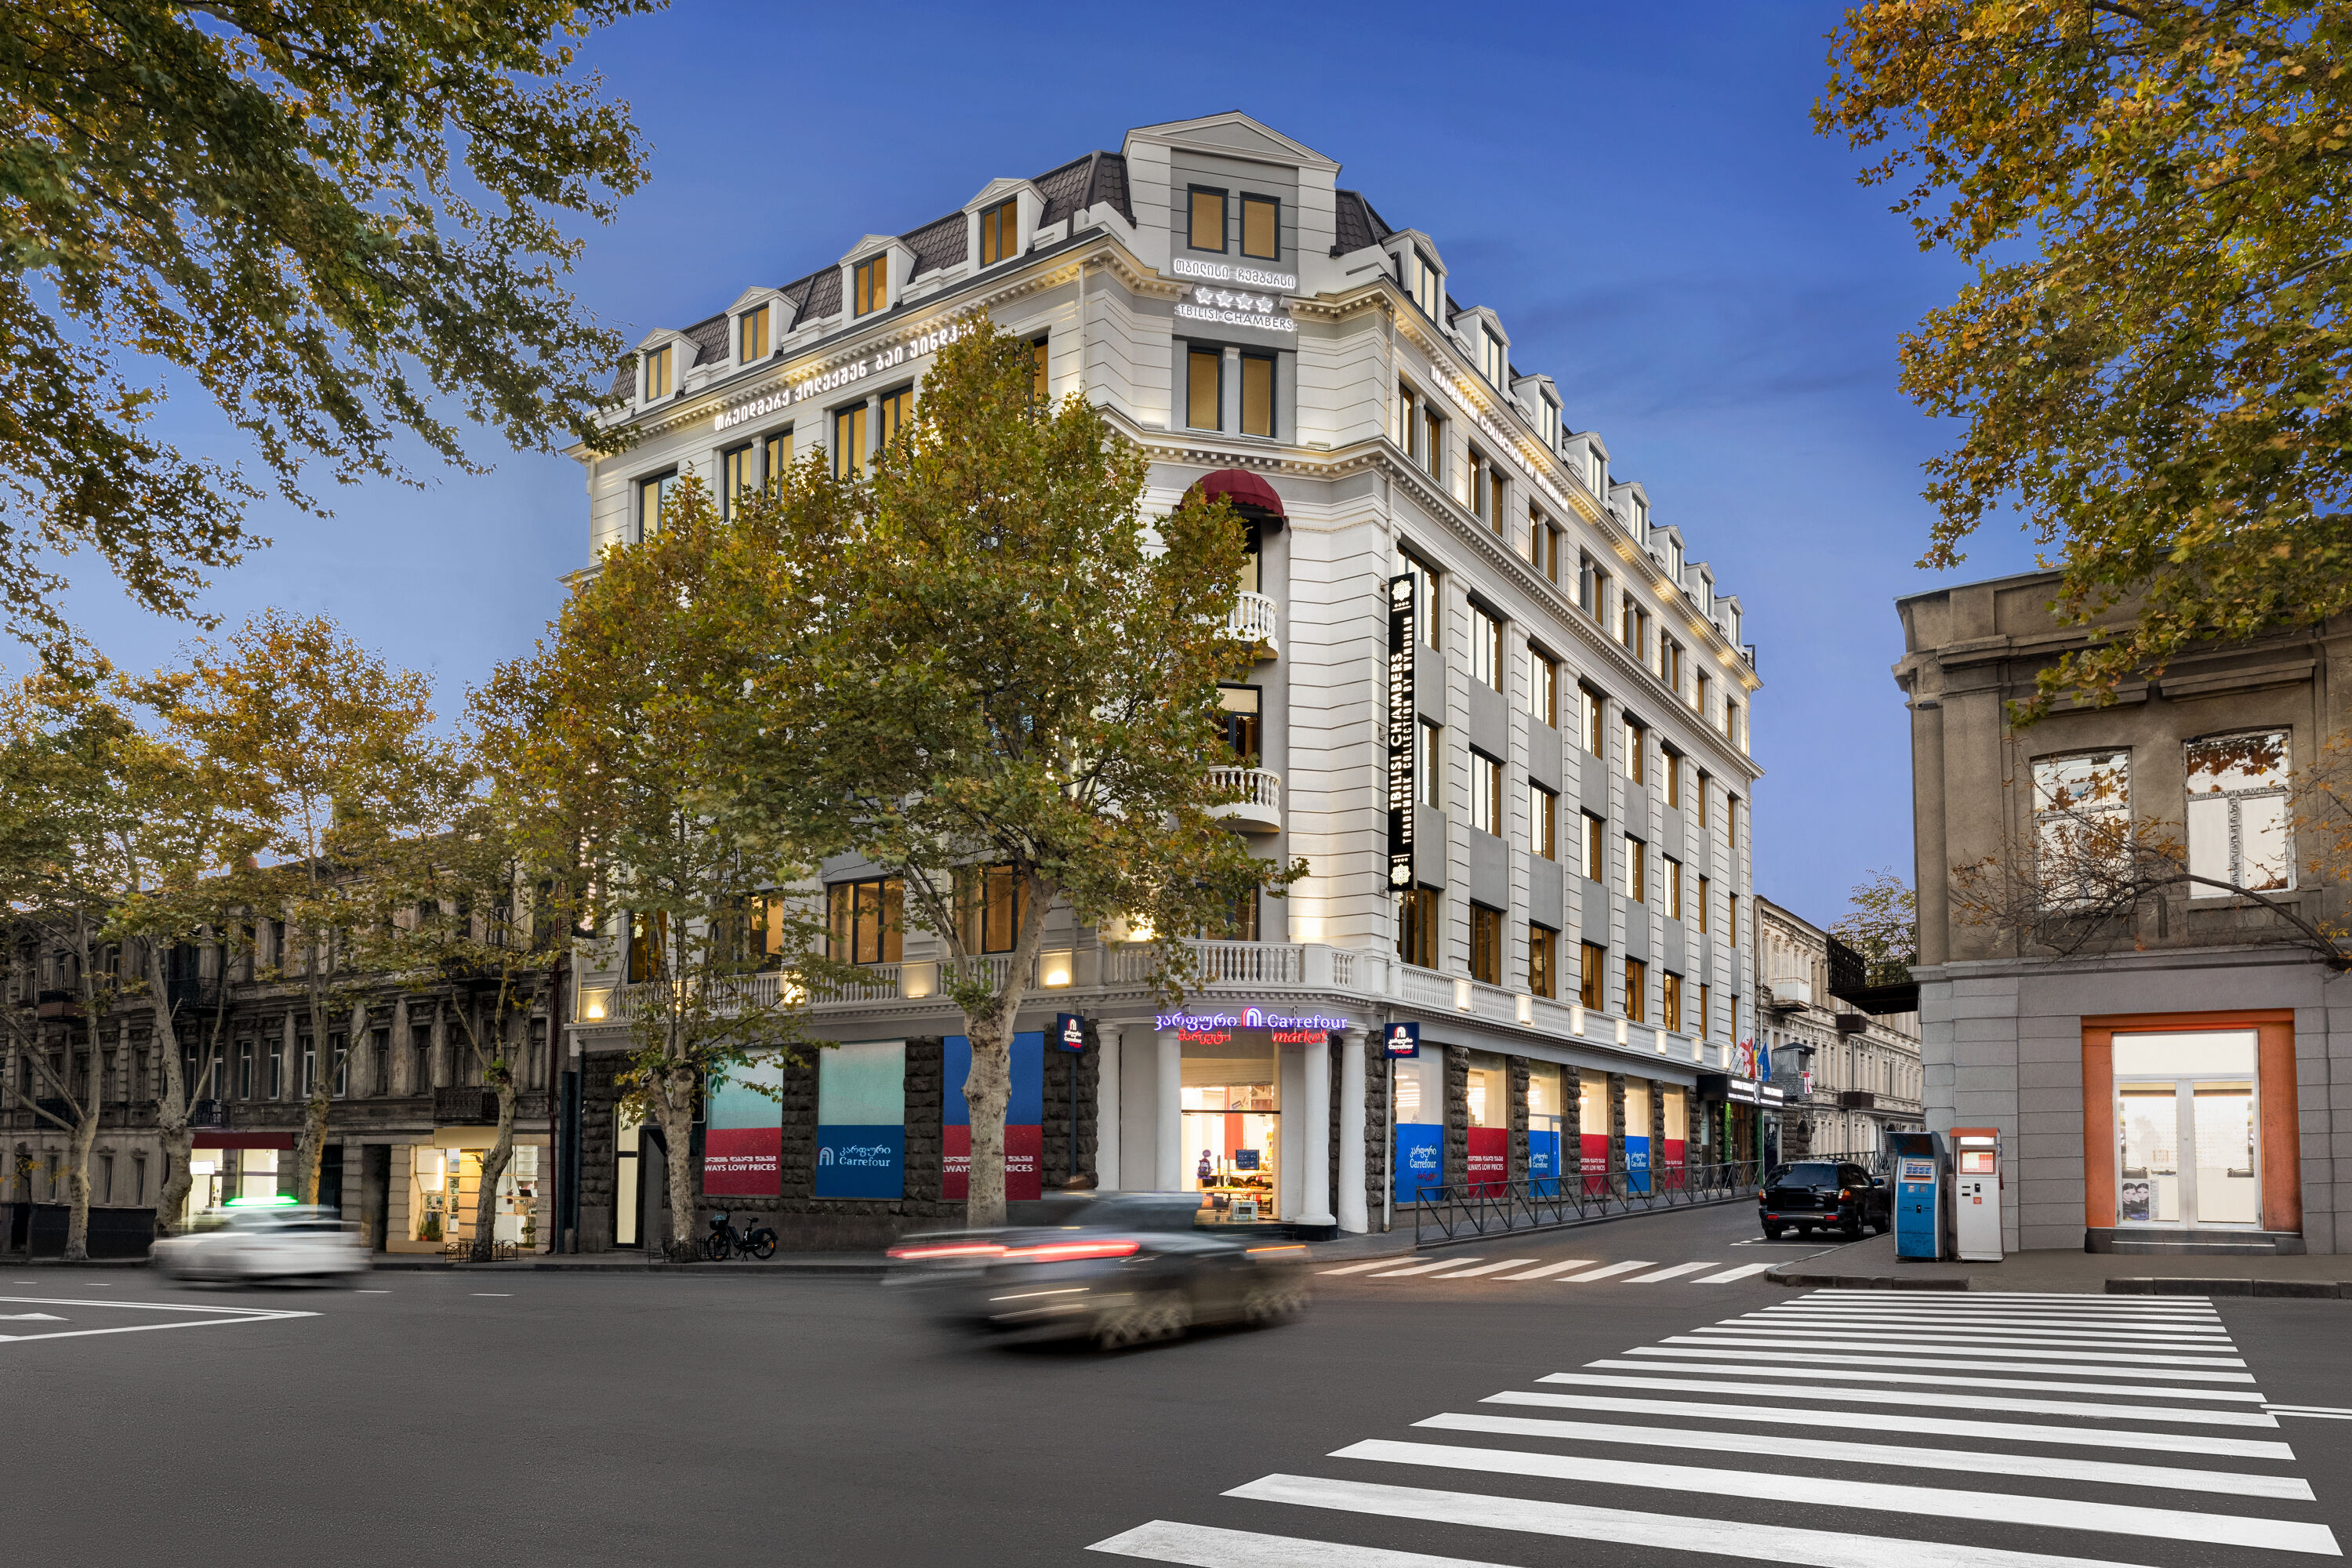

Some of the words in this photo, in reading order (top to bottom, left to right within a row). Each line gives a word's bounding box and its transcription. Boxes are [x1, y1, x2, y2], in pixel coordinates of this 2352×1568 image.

[1179, 304, 1218, 320] TBILISI
[1223, 311, 1294, 331] CHAMBERS
[1431, 365, 1479, 423] TRADEMARK
[1480, 416, 1525, 468] COLLECTION
[1526, 461, 1535, 478] BY
[1403, 616, 1413, 672] WYNDHAM
[1403, 678, 1413, 692] BY
[1390, 652, 1403, 747] CHAMBERS
[1403, 699, 1413, 769] COLLECTION
[1390, 755, 1403, 811] TBILISI
[1403, 777, 1412, 845] TRADEMARK
[1153, 1011, 1238, 1031] კარფური
[1267, 1014, 1348, 1029] Carrefour
[1272, 1029, 1329, 1045] market
[839, 1156, 891, 1167] Carrefour
[1410, 1158, 1437, 1168] Carrefour
